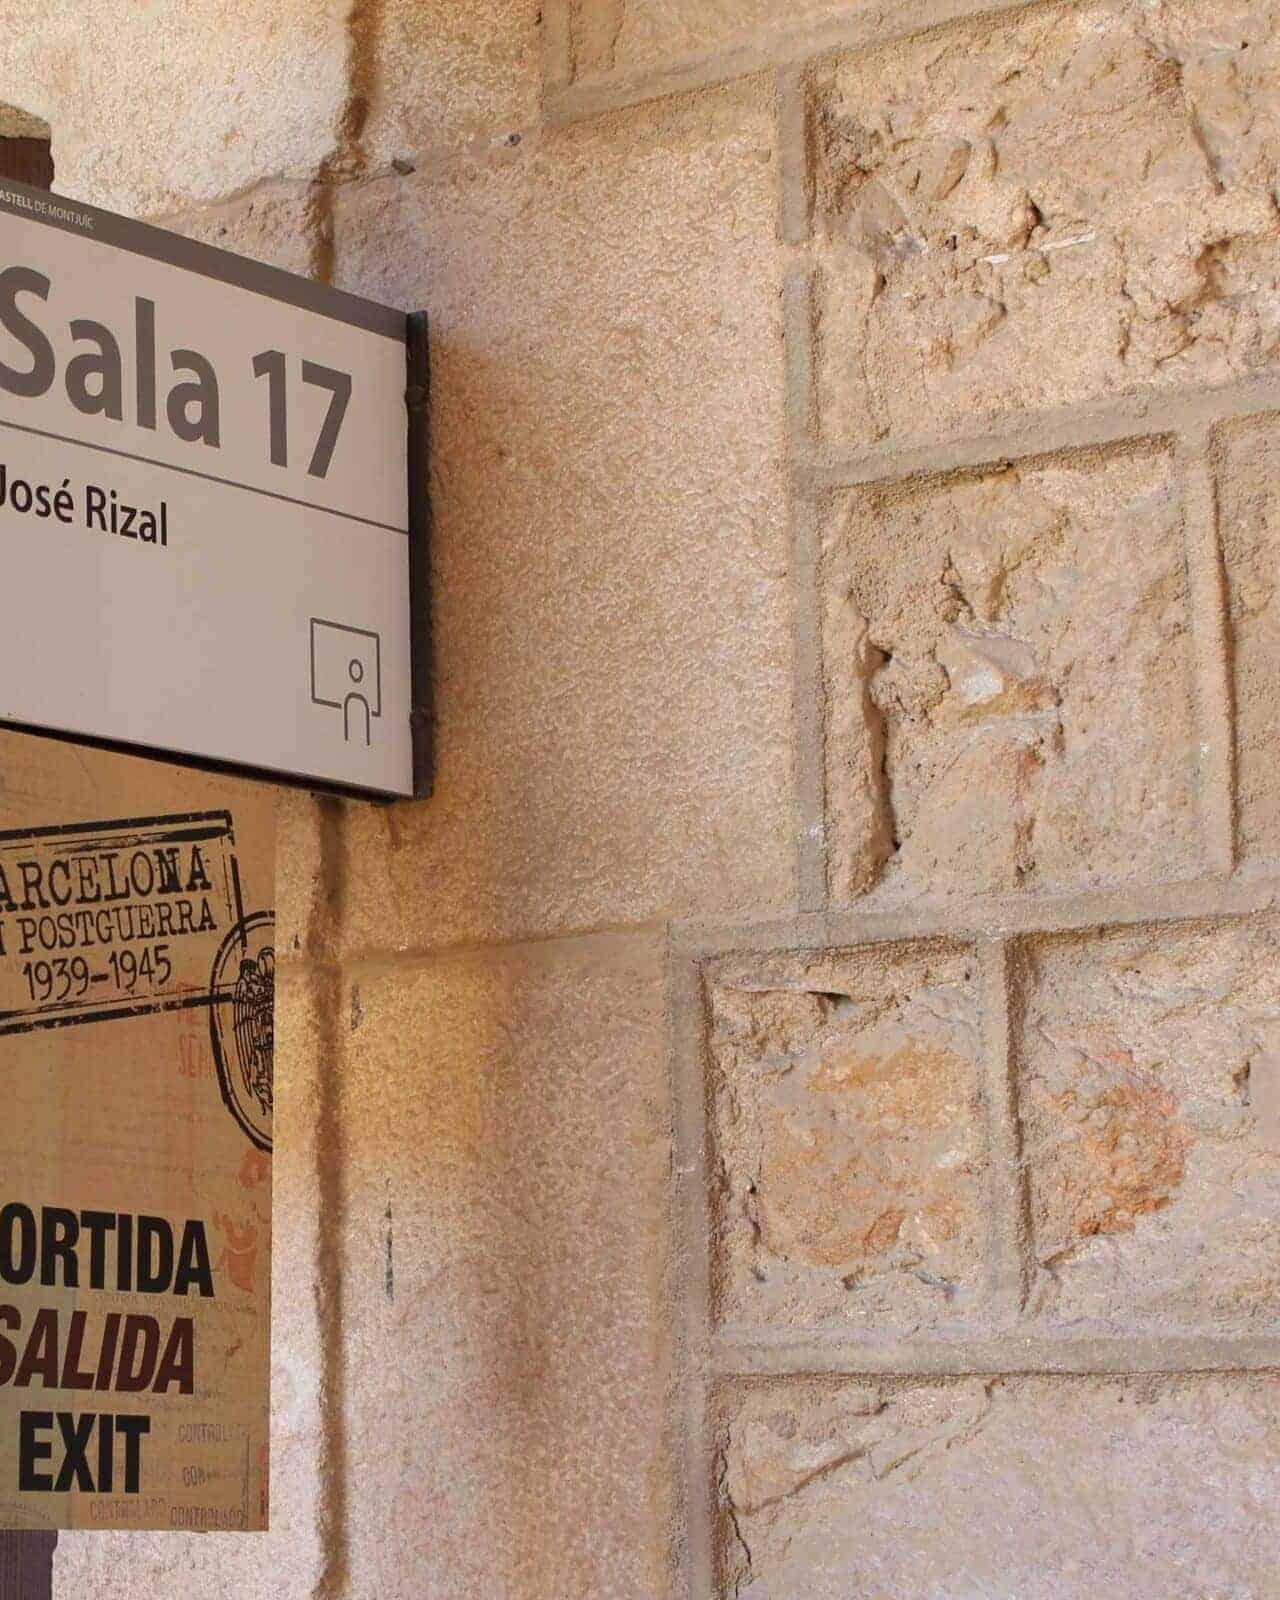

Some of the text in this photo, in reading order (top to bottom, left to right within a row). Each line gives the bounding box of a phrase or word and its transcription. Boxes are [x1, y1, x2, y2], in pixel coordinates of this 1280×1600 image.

[34, 200, 48, 214] DE
[252, 349, 352, 479] 17
[85, 485, 168, 546] Rizal
[16, 897, 218, 954] POSTGUERRA
[19, 1411, 151, 1494] EXIT
